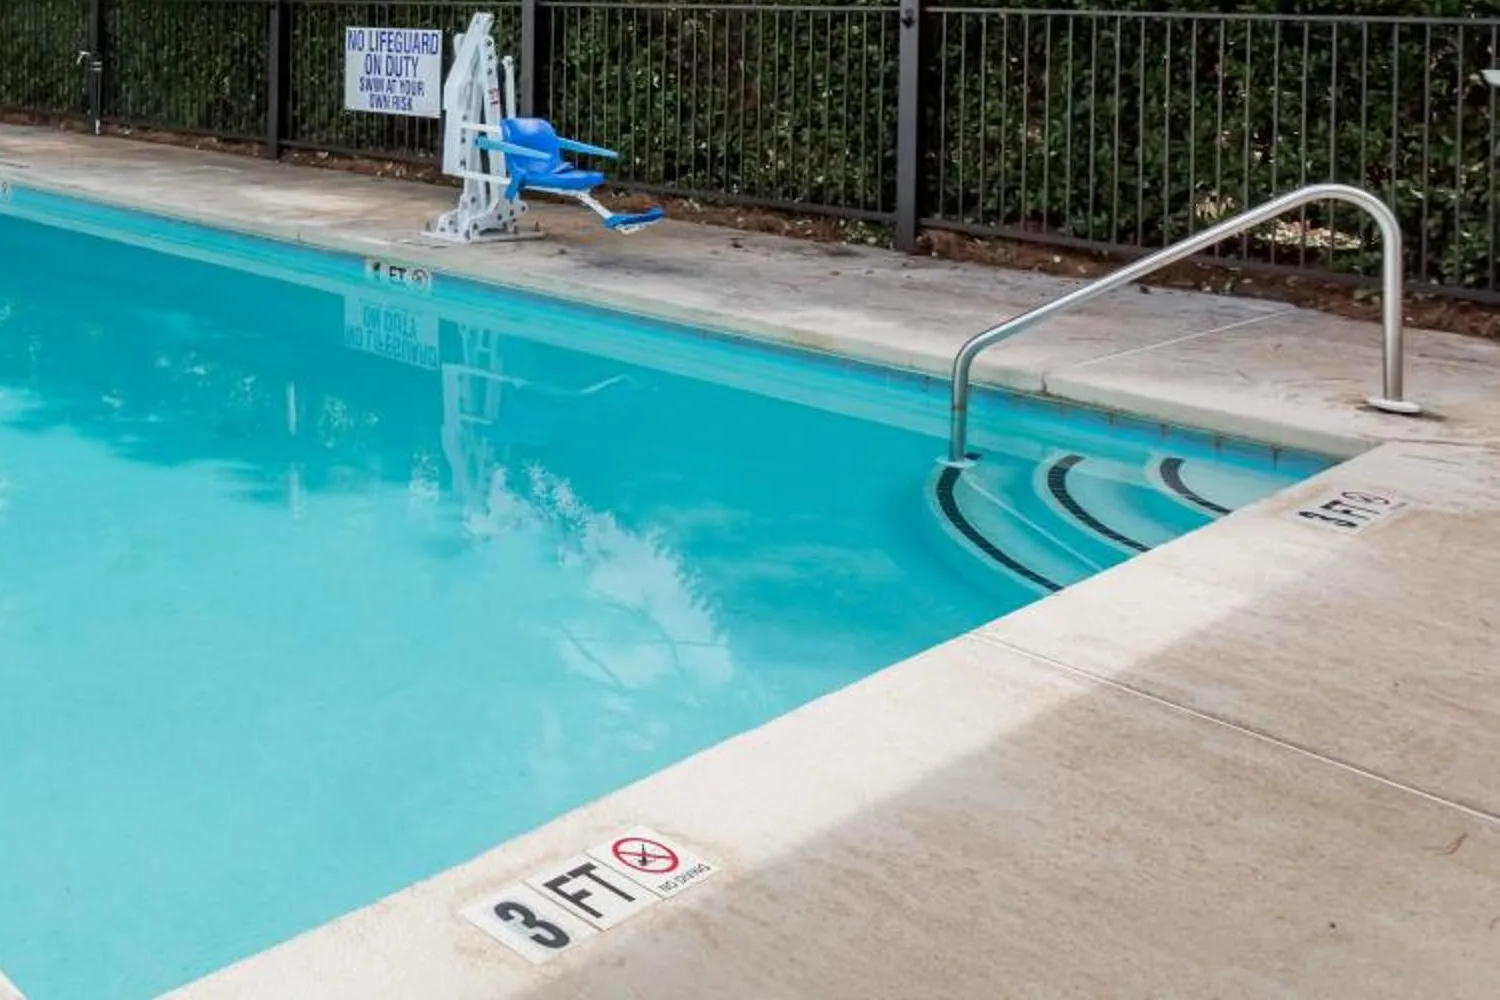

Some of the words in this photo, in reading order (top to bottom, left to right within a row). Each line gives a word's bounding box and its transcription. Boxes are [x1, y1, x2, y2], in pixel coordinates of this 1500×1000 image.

[347, 30, 364, 52] NO
[368, 30, 439, 55] LIFEGUARD
[365, 53, 381, 76] ON
[385, 55, 418, 78] DUTY
[359, 76, 384, 92] SWIM
[385, 79, 397, 94] AT
[400, 80, 424, 97] YOUR
[369, 93, 390, 109] OWN
[391, 95, 413, 112] RISK
[1298, 510, 1358, 527] 3
[1320, 499, 1381, 521] FT
[494, 901, 570, 949] 3
[543, 862, 636, 918] FT
